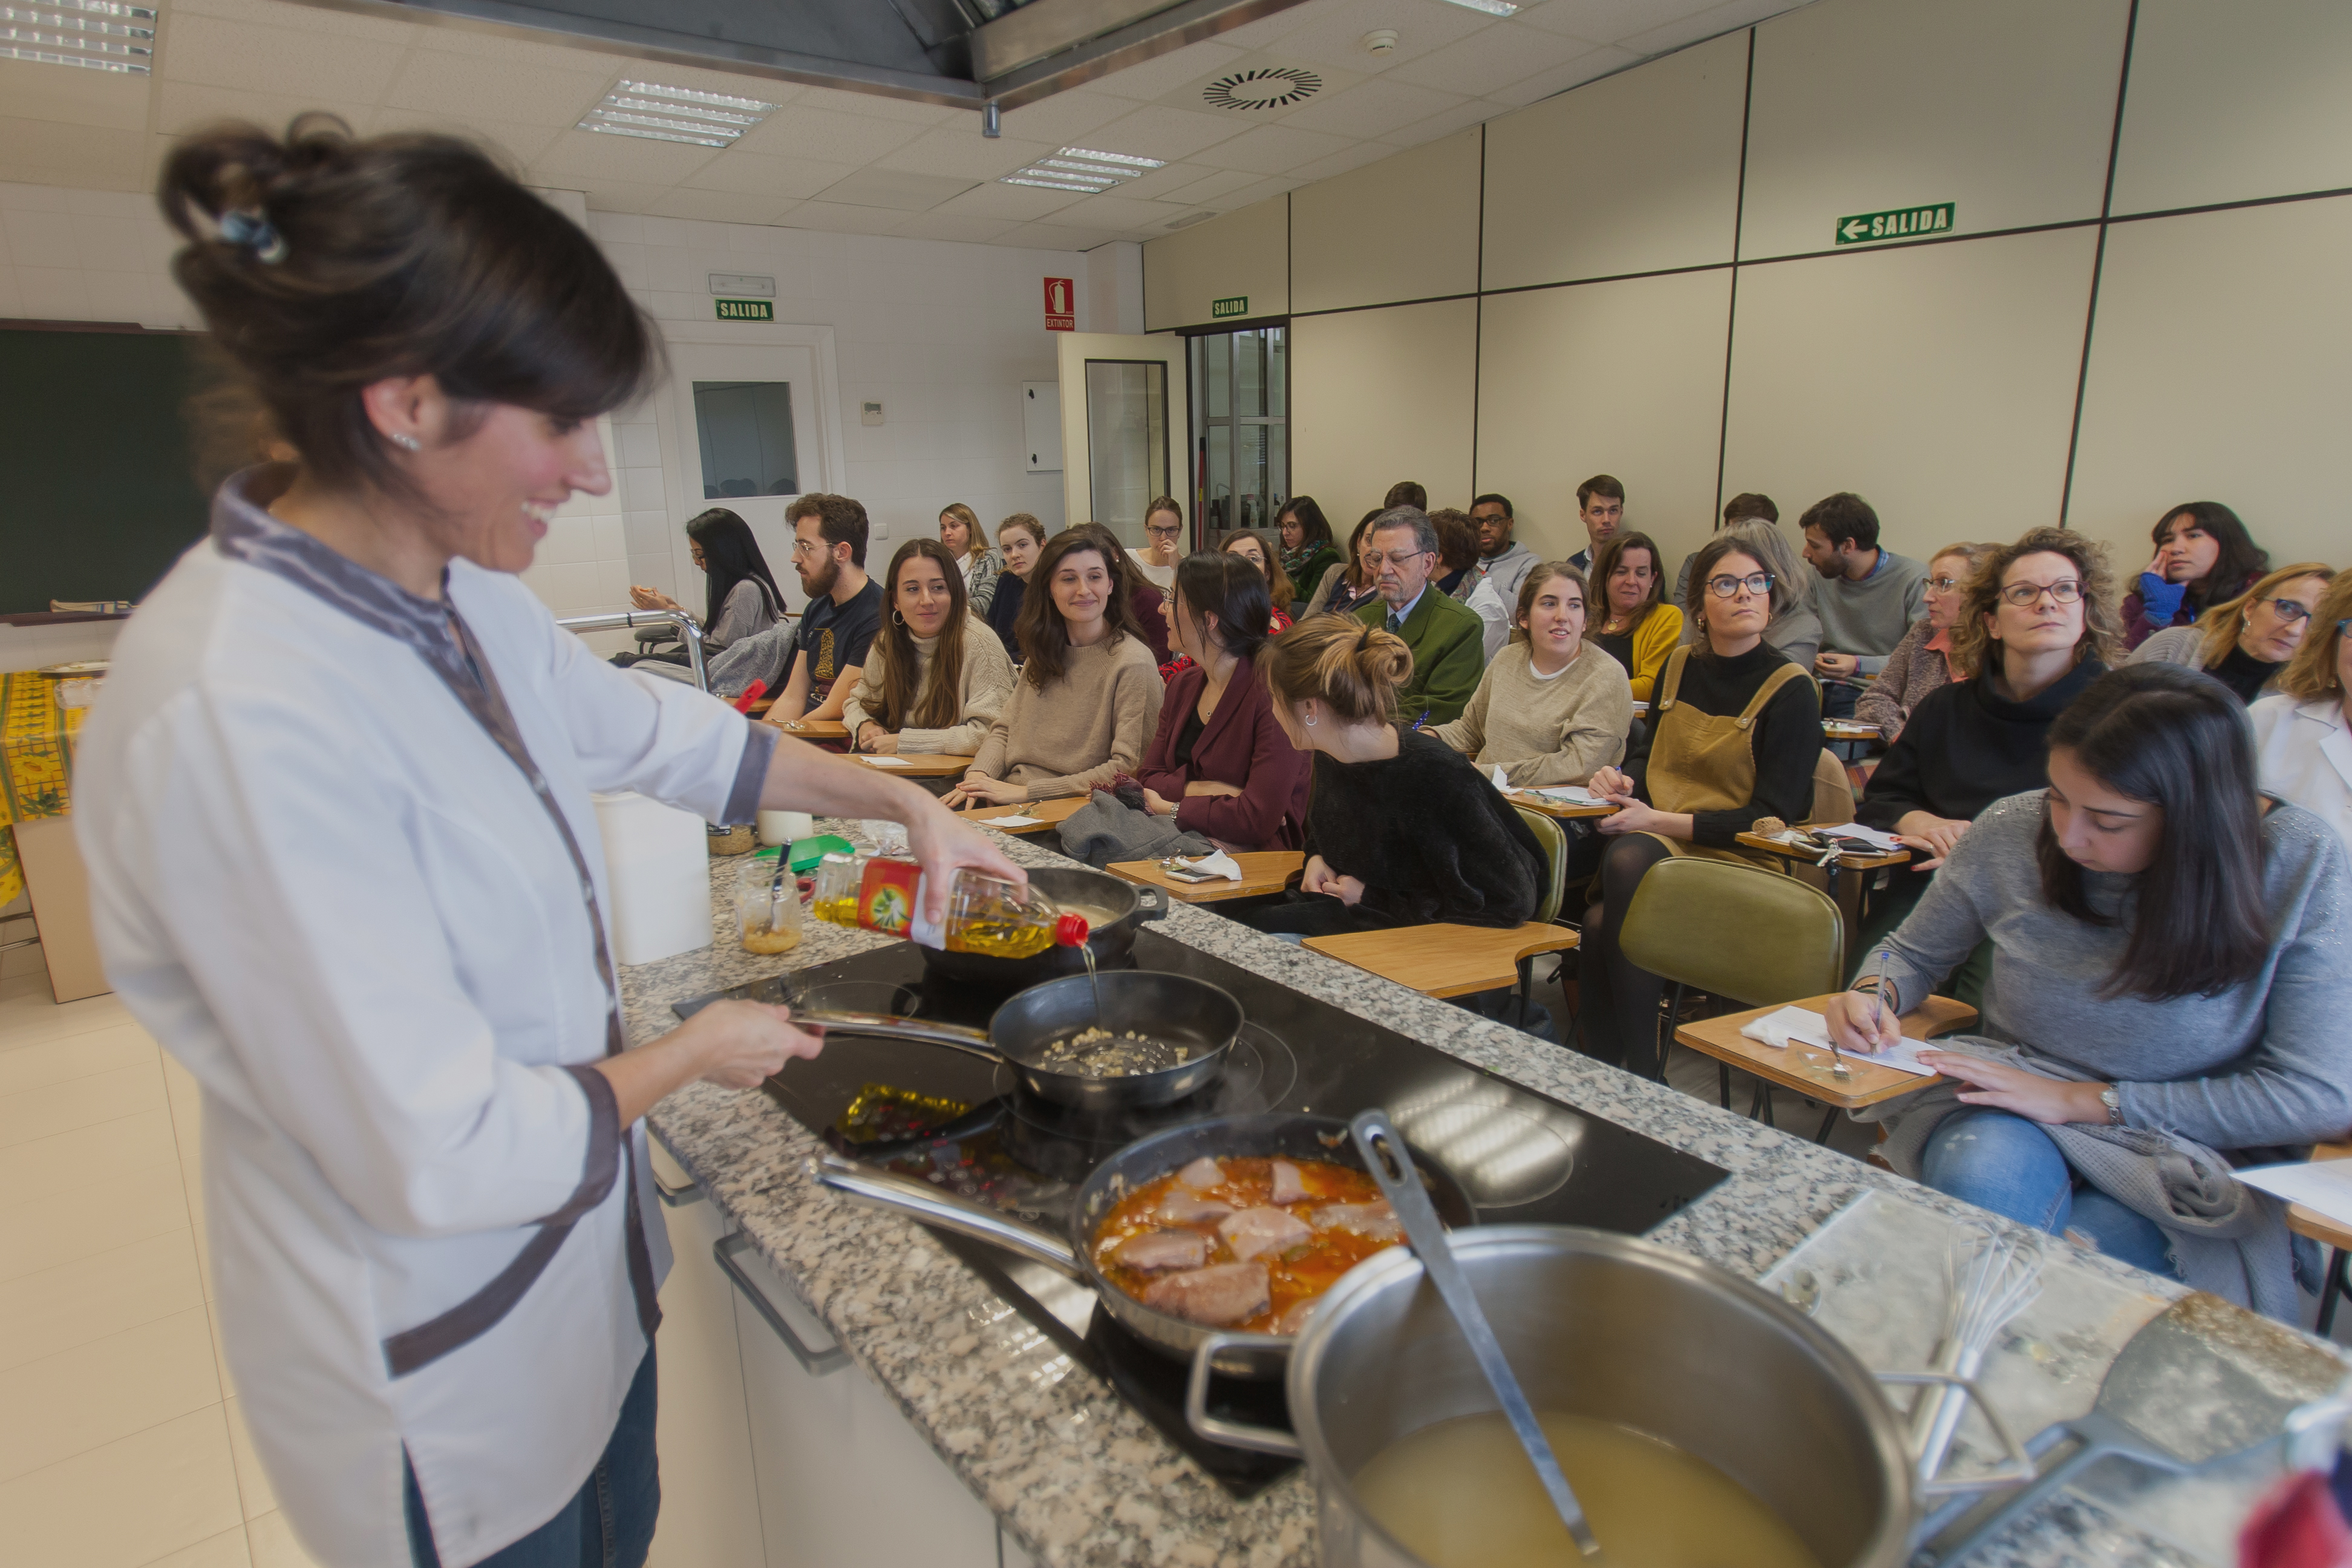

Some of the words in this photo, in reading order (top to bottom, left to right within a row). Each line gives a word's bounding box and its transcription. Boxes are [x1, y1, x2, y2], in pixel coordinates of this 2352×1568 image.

[1872, 208, 1947, 237] SALIDA
[720, 302, 768, 318] SALIDA
[1215, 300, 1244, 315] SALIDA
[1047, 318, 1073, 328] EXTINTOR
